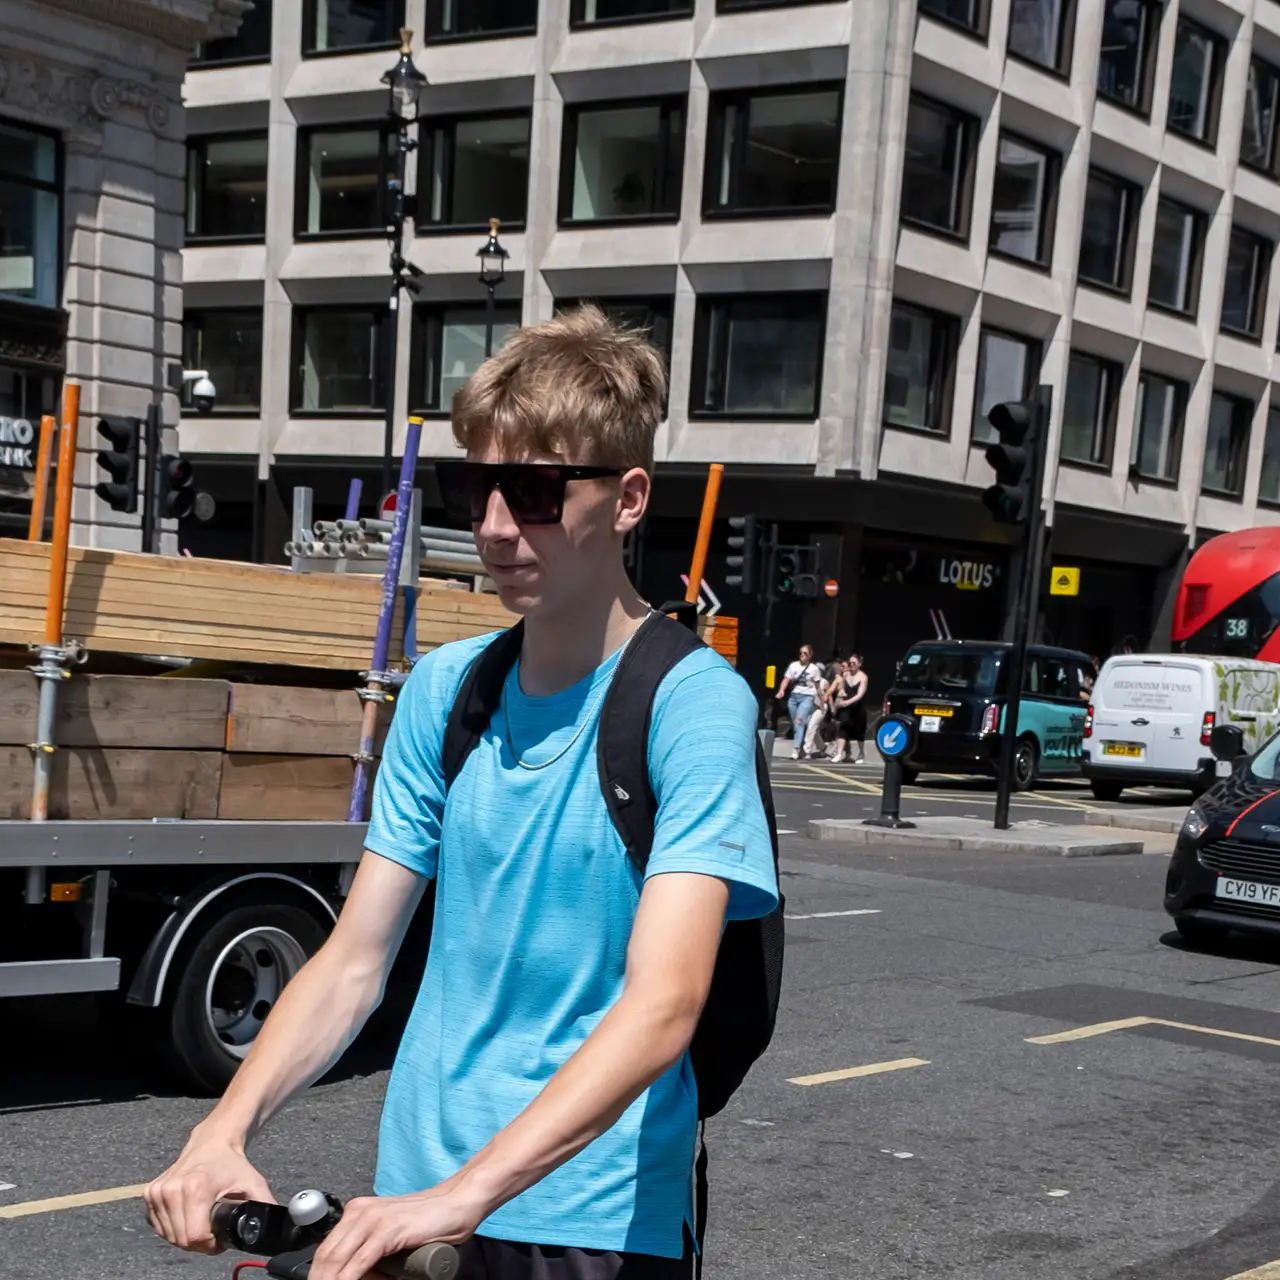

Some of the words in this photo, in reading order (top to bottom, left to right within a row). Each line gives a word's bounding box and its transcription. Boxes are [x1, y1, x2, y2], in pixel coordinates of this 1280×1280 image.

[939, 559, 993, 587] LOTUS
[1226, 618, 1248, 637] 38
[1113, 680, 1160, 691] HEDONISM
[1162, 682, 1193, 692] WINES
[1225, 881, 1257, 898] CY19
